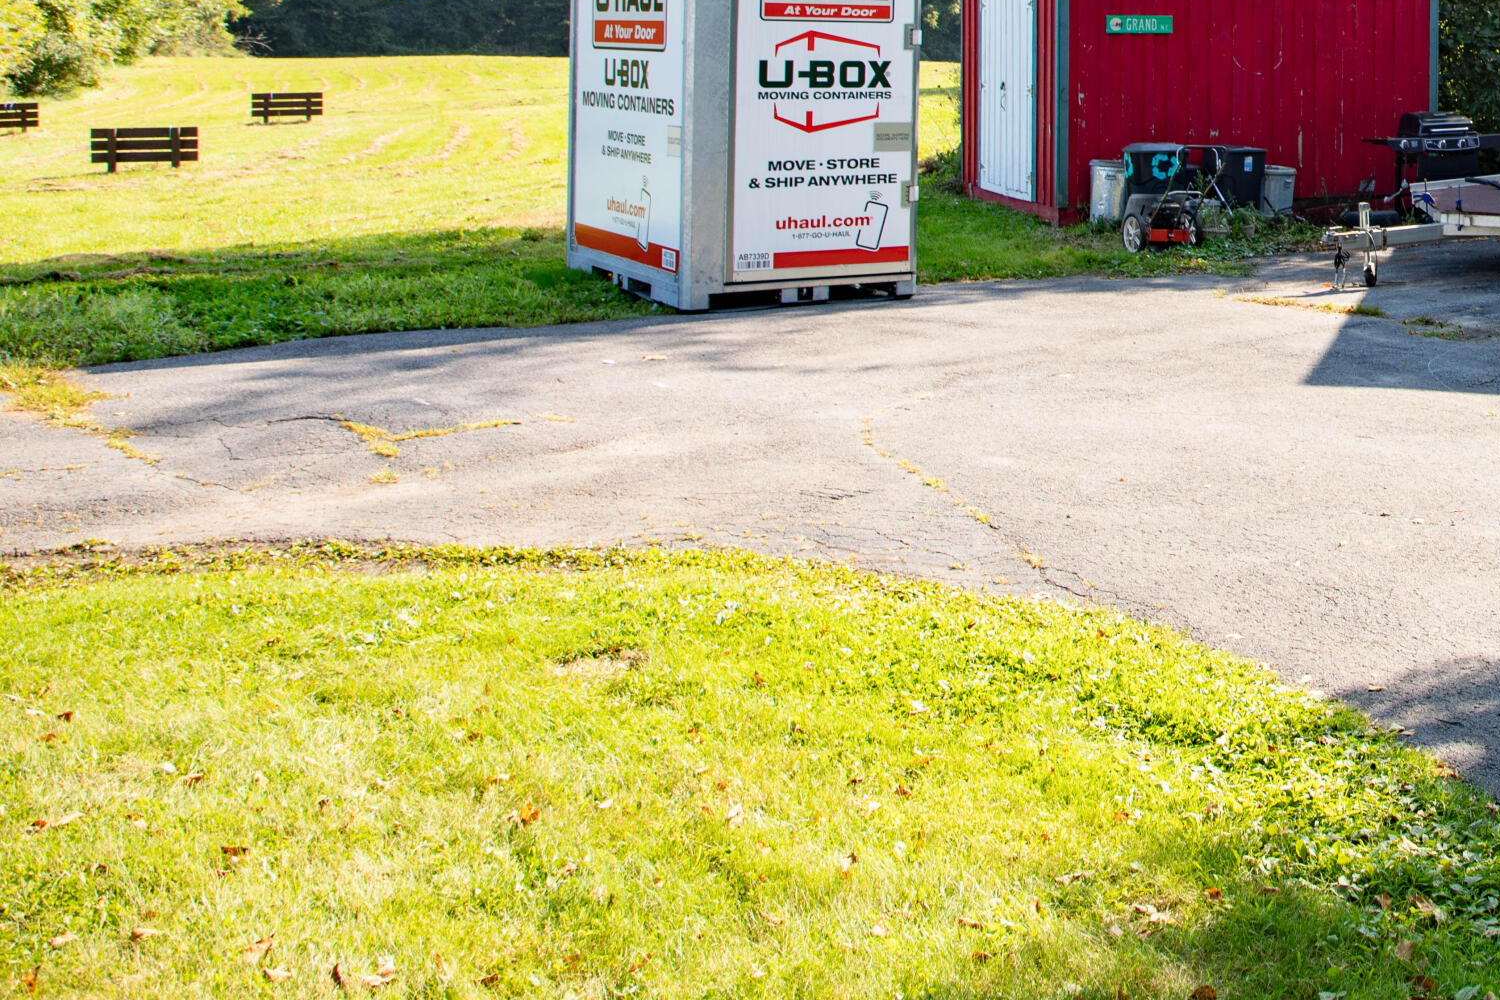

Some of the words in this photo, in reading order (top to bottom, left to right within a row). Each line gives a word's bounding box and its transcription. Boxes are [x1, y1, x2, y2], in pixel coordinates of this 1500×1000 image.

[784, 5, 801, 15] At
[805, 5, 838, 16] Your
[841, 6, 877, 17] Door
[604, 23, 614, 39] At
[615, 24, 633, 39] Your
[634, 24, 656, 40] Door
[1126, 17, 1157, 31] GRAND
[604, 58, 649, 89] U-BOX
[759, 60, 892, 88] U-BOX
[582, 91, 616, 109] MOVING
[617, 93, 675, 116] CONTAINERS
[758, 91, 809, 100] MOVING
[812, 91, 892, 100] CONTAINERS
[608, 129, 624, 142] MOVE
[627, 132, 646, 146] STORE
[606, 146, 620, 158] SHIP
[621, 149, 652, 164] ANYWHERE
[768, 160, 816, 171] MOVE
[826, 157, 880, 169] STORE
[748, 177, 761, 189] &
[765, 176, 804, 188] SHIP
[807, 173, 897, 187] ANYWHERE
[607, 195, 645, 219] uhaul.com
[775, 214, 871, 230] uhaul.com
